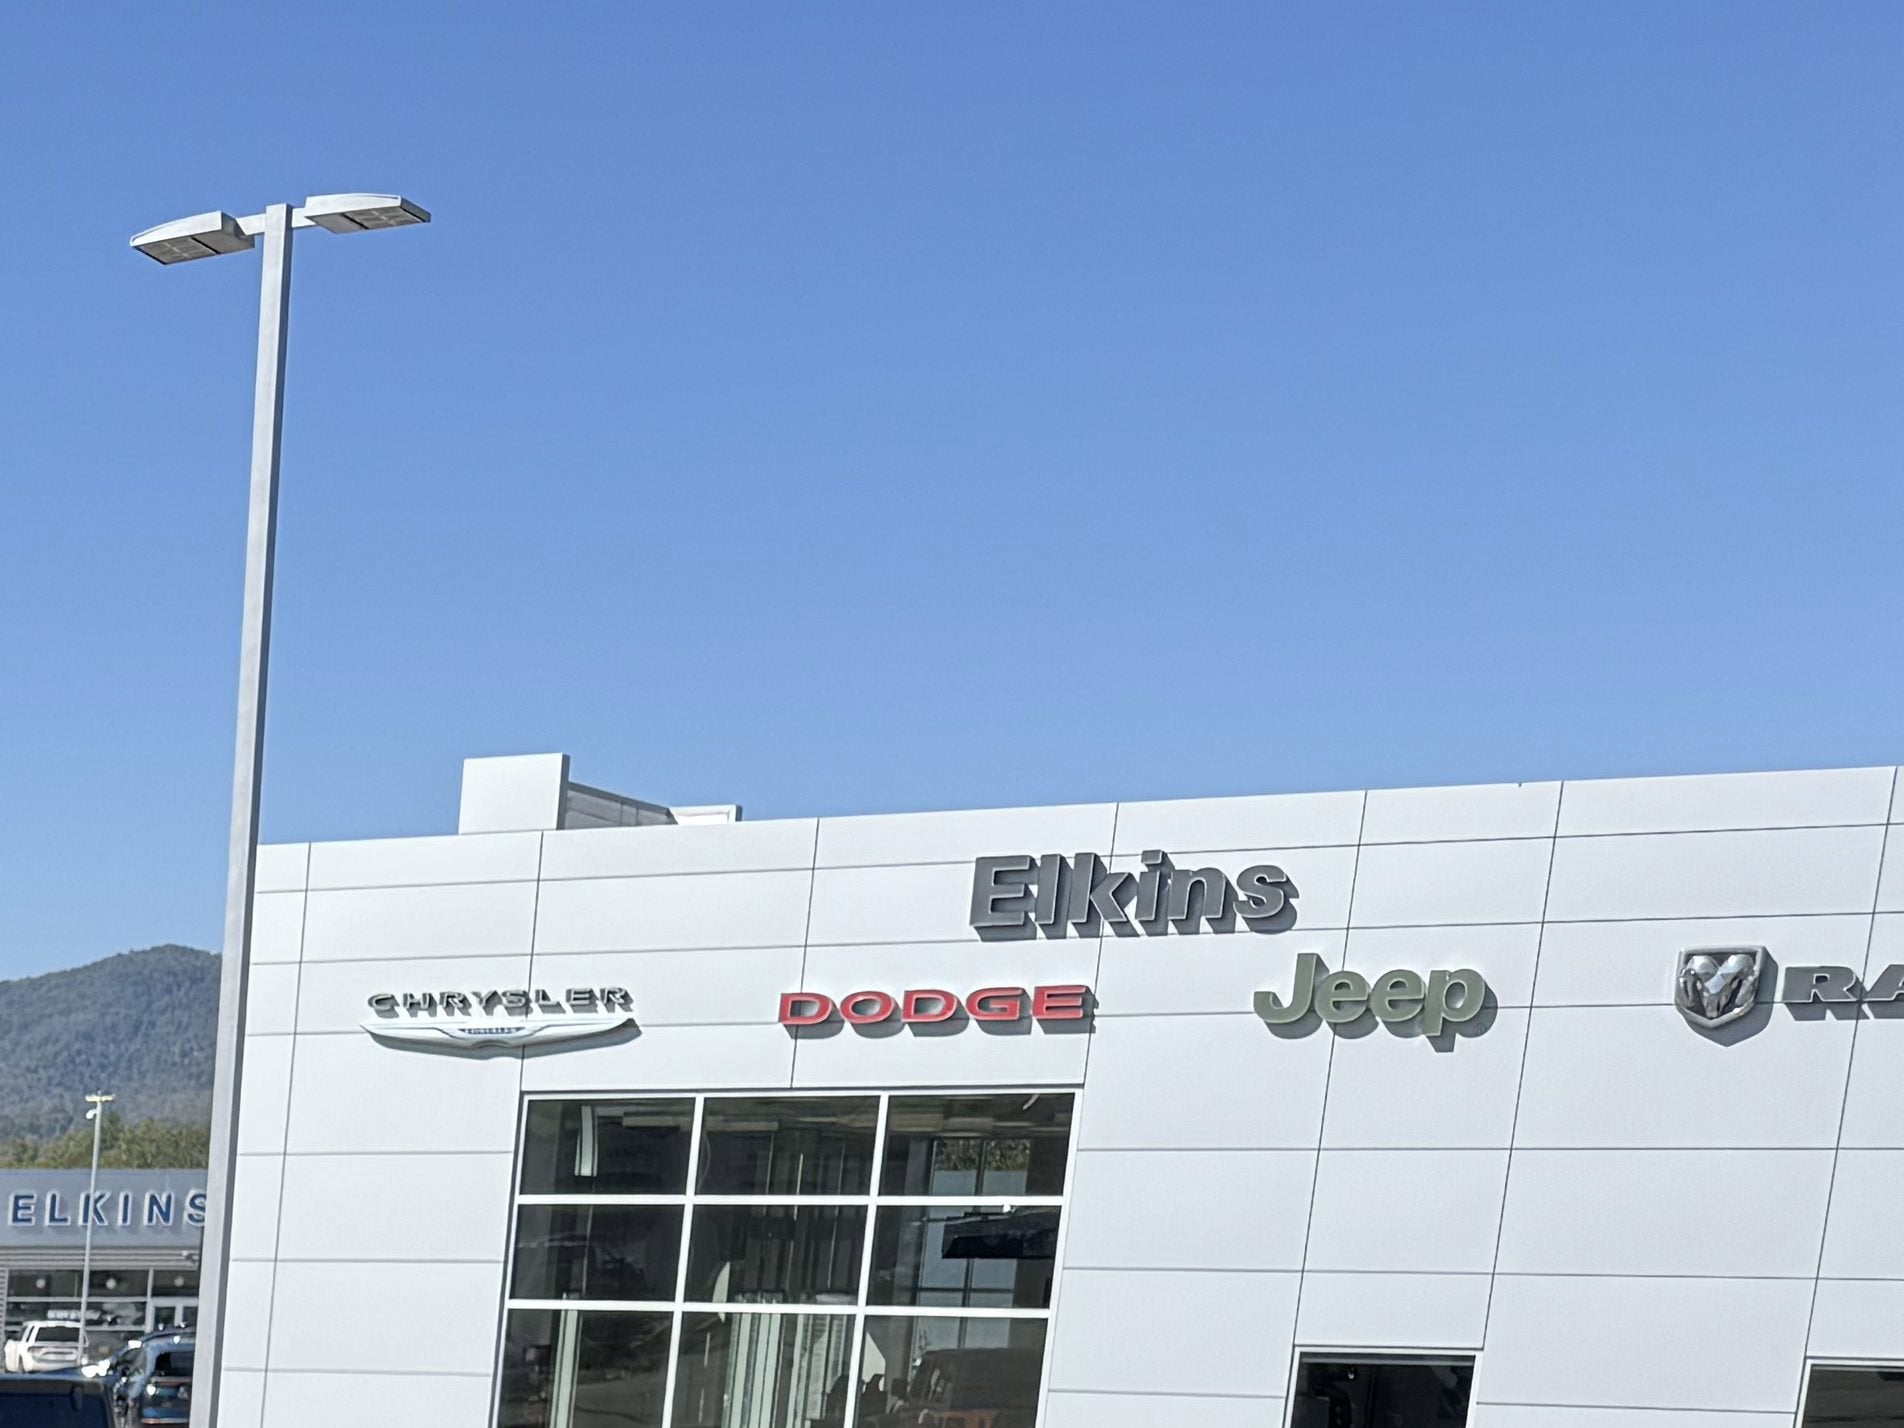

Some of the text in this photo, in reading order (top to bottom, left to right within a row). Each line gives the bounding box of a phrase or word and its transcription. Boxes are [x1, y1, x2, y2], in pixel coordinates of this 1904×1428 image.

[970, 850, 1296, 932] Elkins
[368, 987, 633, 1014] CHRYSLER
[778, 985, 1091, 1026] DODGE
[1253, 953, 1487, 1037] Jeep
[8, 1190, 207, 1227] ELKINS
